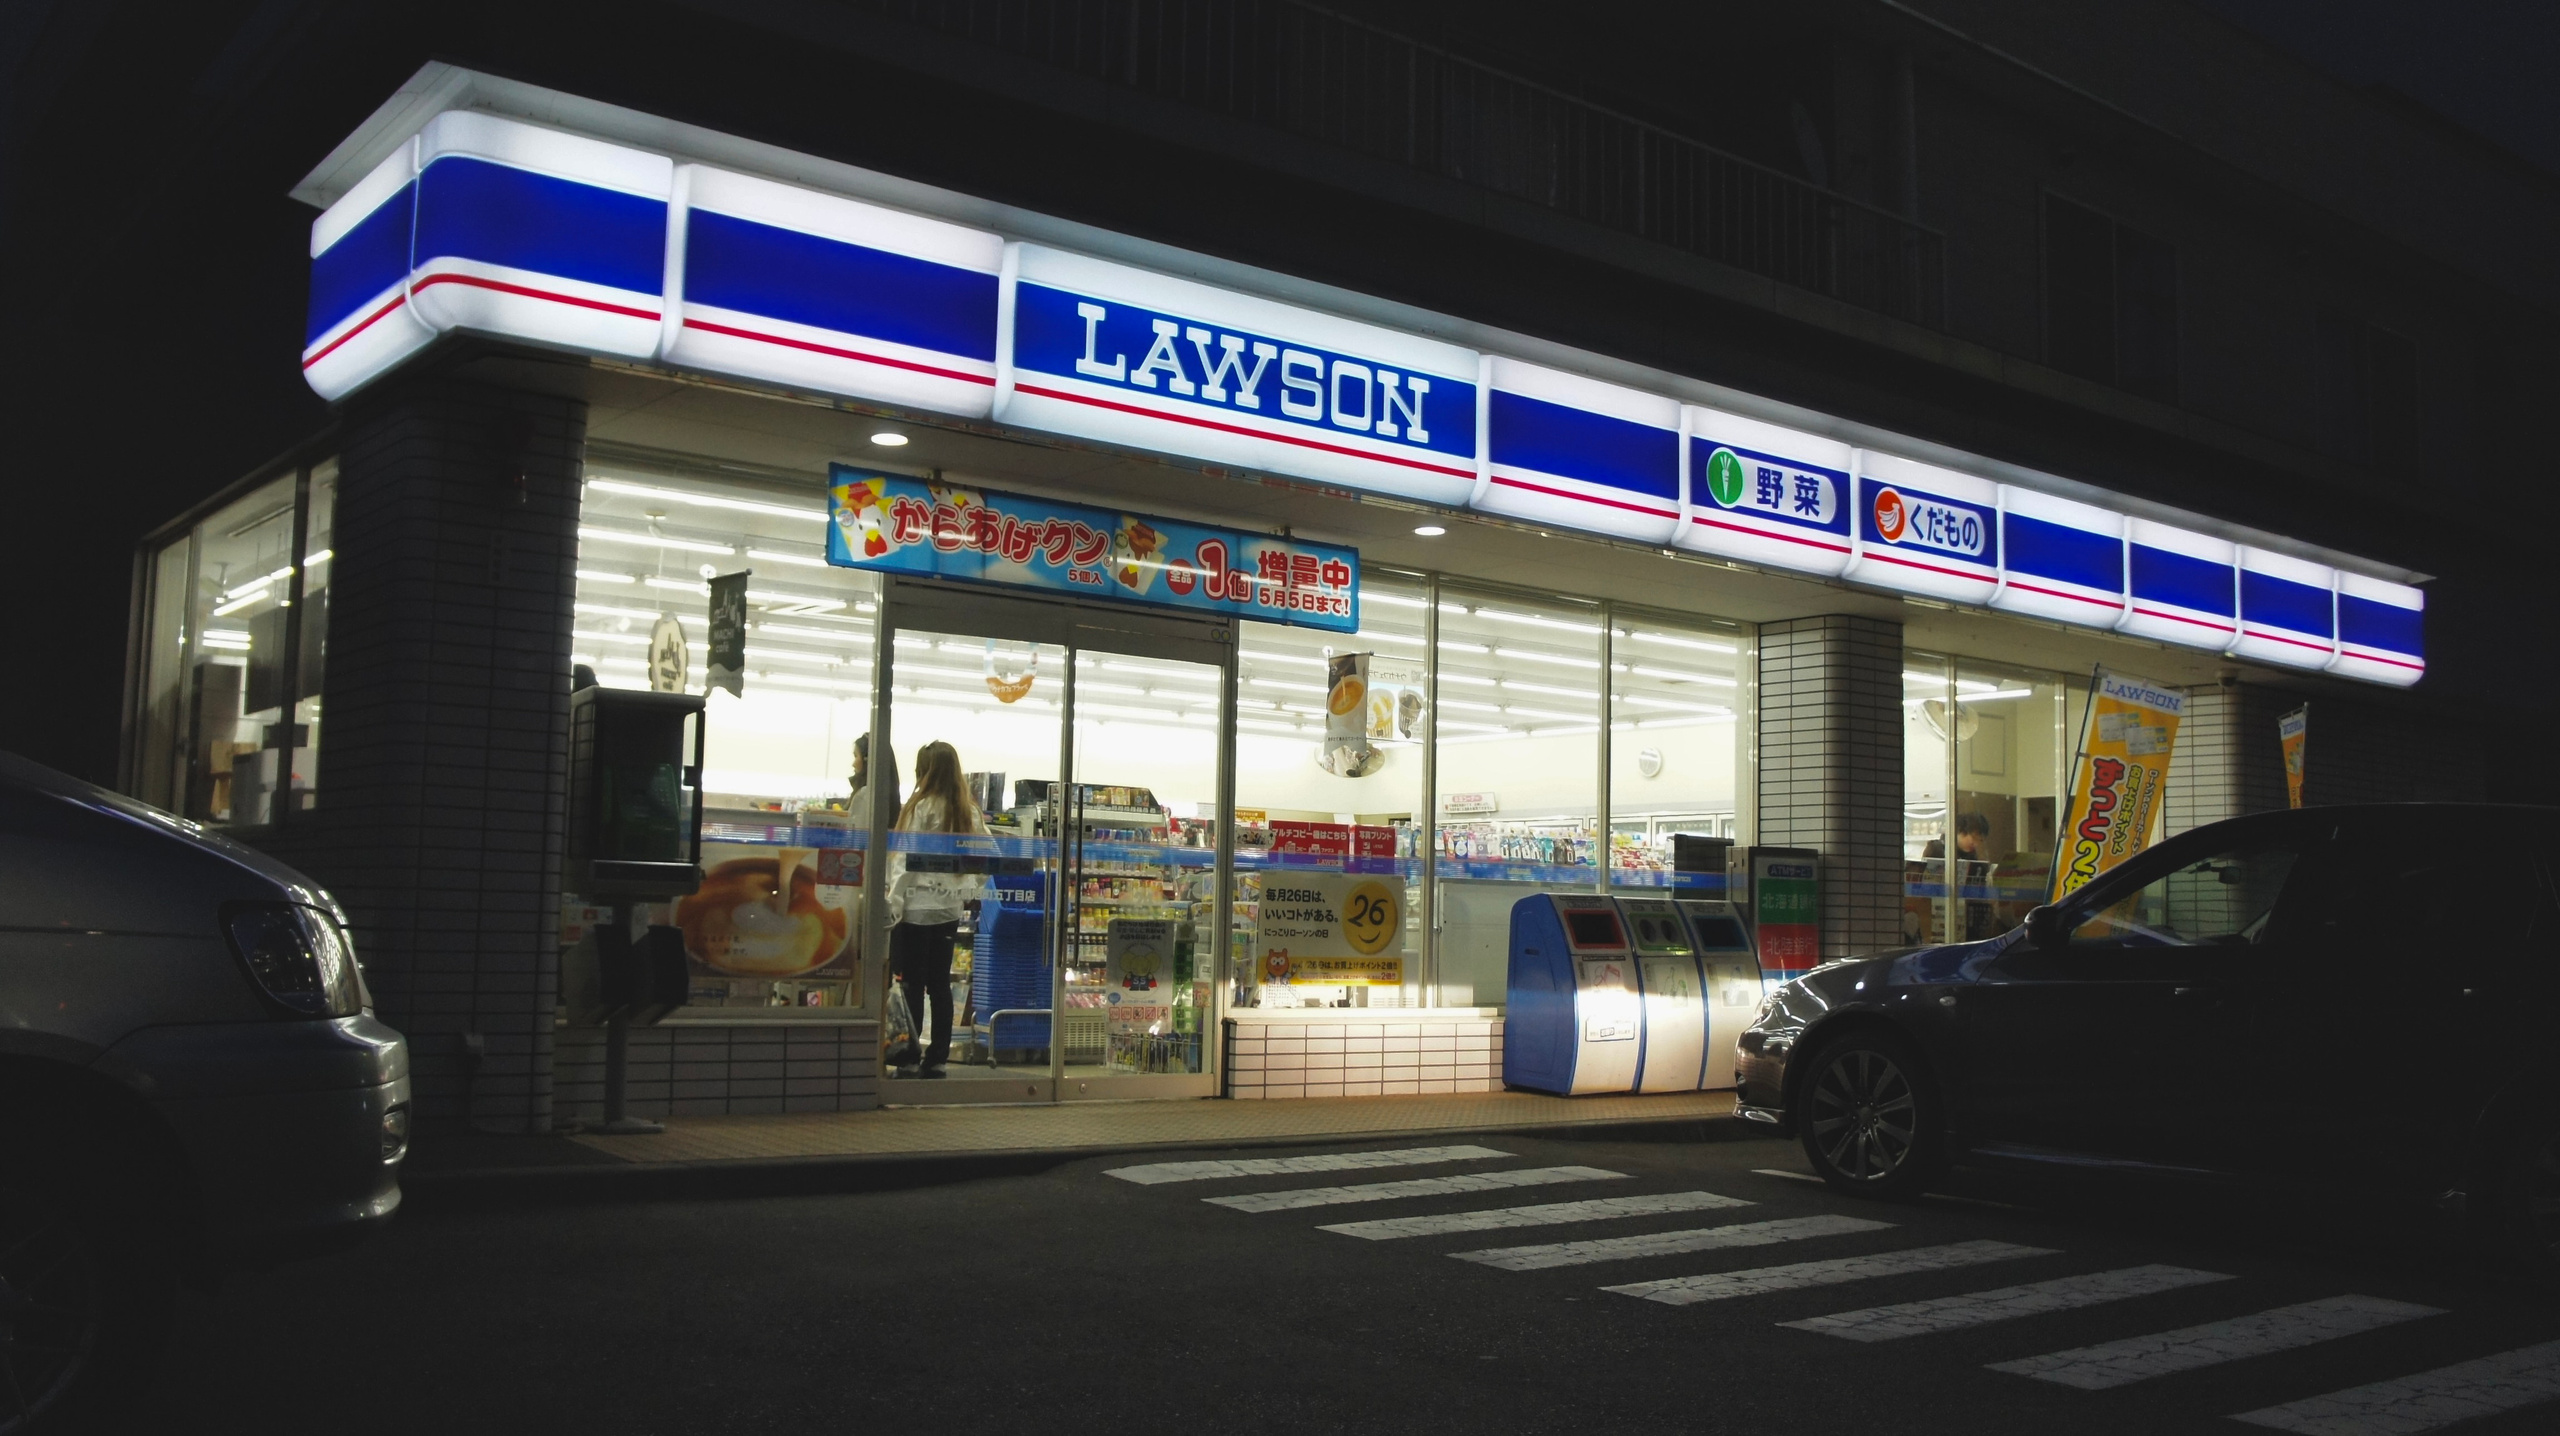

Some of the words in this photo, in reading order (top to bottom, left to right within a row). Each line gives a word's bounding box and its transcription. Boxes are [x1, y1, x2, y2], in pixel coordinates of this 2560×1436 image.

[1076, 302, 1430, 444] LAWSON
[1756, 467, 1820, 517] 野菜
[891, 498, 1108, 566] からあげクン
[1910, 504, 1979, 550] くだもの
[1069, 569, 1103, 585] 5個入
[1170, 568, 1192, 584] 全品
[1258, 550, 1350, 593] 増量中
[2105, 681, 2181, 711] LAWSON
[2112, 765, 2144, 855] お買上げポイント
[1265, 888, 1326, 904] 毎月26日は、
[1348, 894, 1388, 927] 26
[1265, 909, 1339, 923] いいコトがある。
[1264, 928, 1329, 939] にっこりローソンの日
[1766, 936, 1814, 956] 北陸銀行
